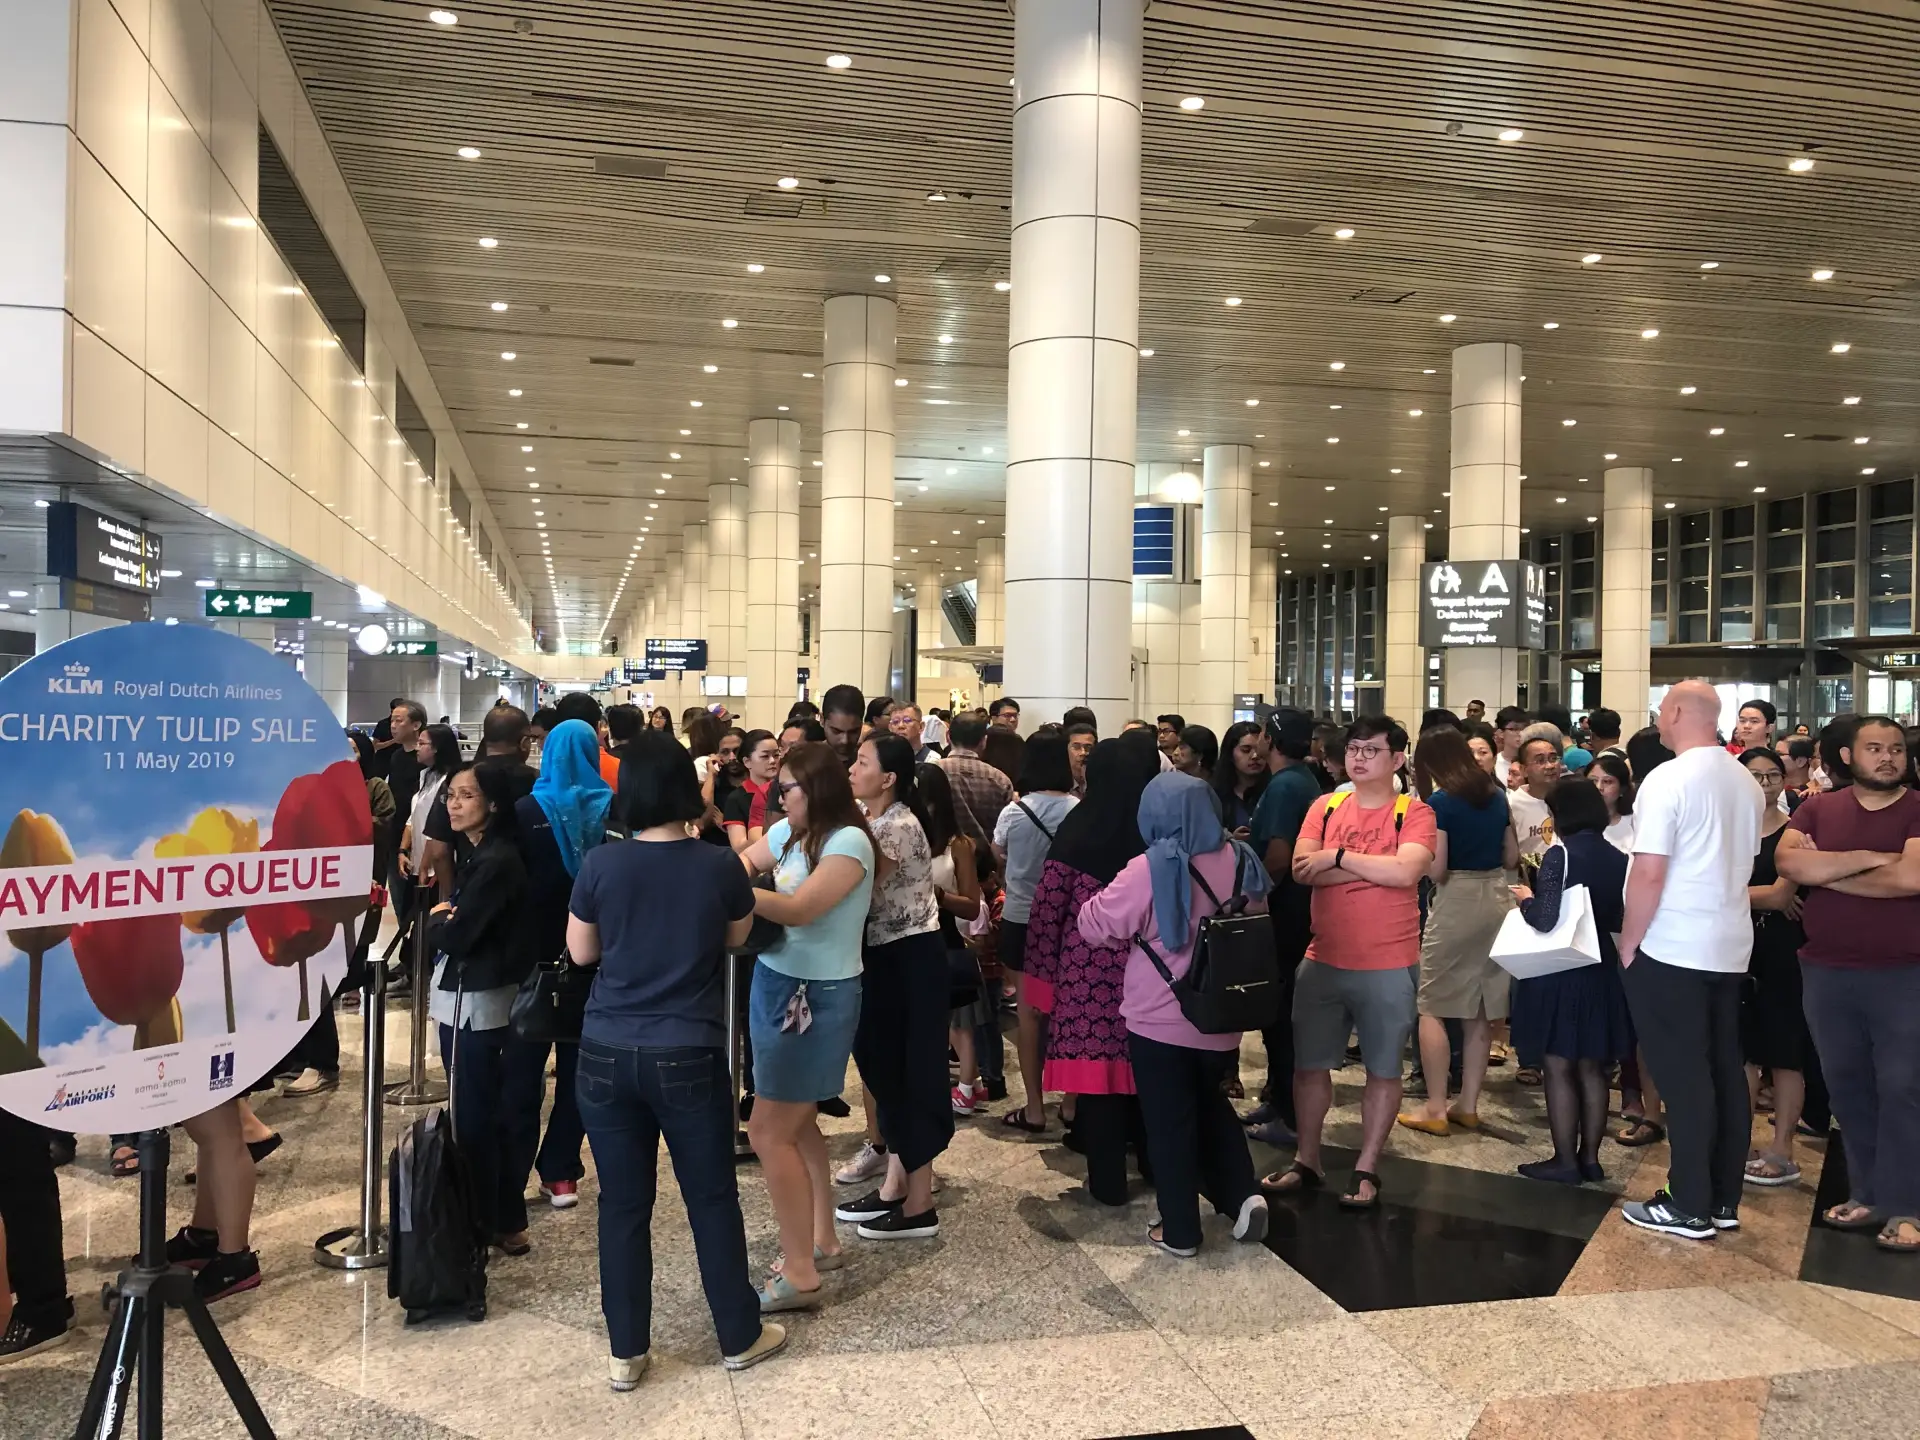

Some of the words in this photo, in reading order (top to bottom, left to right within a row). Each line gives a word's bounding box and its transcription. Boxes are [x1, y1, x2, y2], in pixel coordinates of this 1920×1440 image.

[1479, 563, 1509, 593] A
[48, 678, 103, 694] KLM
[114, 680, 163, 699] Royal
[170, 682, 219, 698] Dutch
[224, 684, 282, 700] Airlines
[0, 713, 145, 742] CHARITY
[157, 715, 241, 742] TULIP
[251, 718, 317, 743] SALE
[104, 752, 125, 769] 11
[136, 752, 180, 772] May
[187, 752, 235, 769] 2019
[204, 855, 341, 897] QUEUE
[63, 1089, 115, 1107] AIRPORTS
[67, 1084, 116, 1098] MALAYSIA
